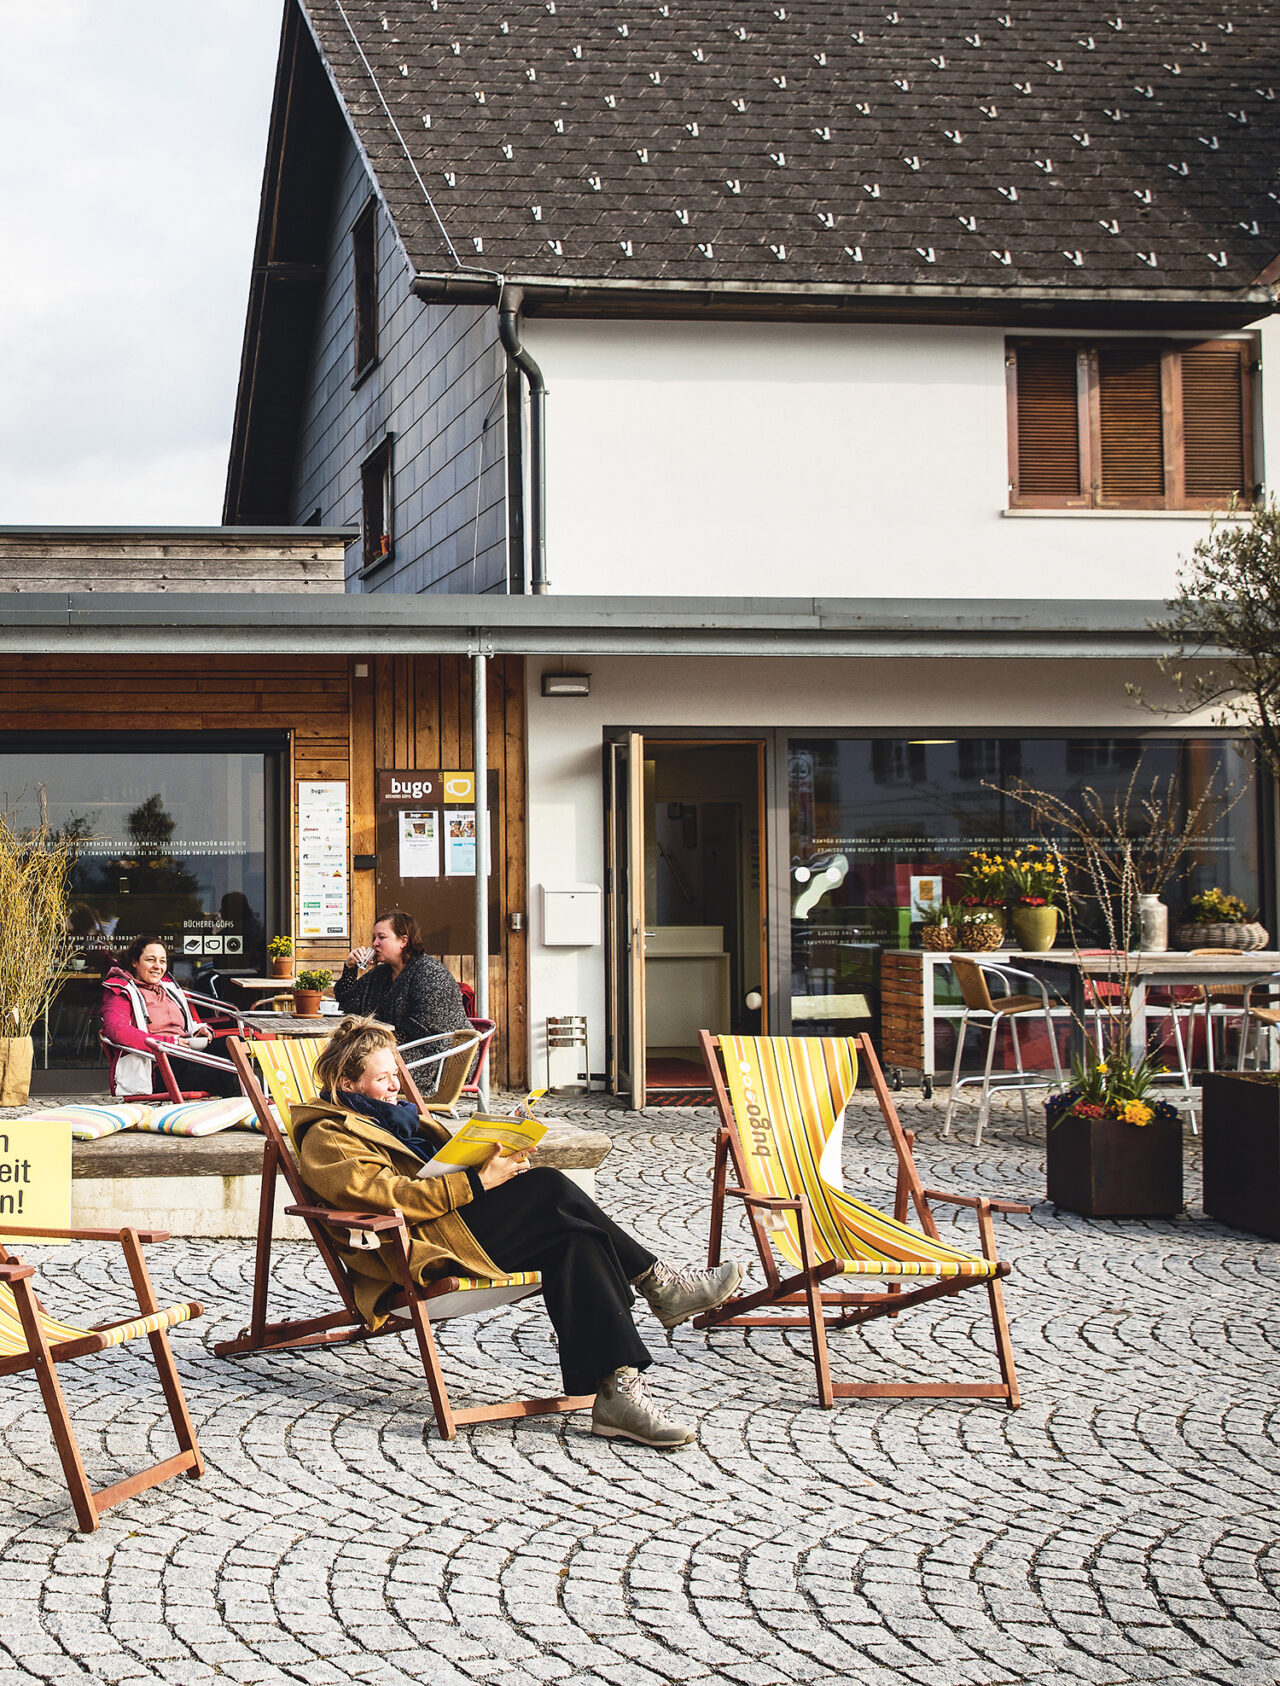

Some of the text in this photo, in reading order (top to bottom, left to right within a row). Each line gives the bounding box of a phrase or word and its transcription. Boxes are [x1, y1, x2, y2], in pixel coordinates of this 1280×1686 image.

[391, 777, 432, 799] bugo
[183, 919, 235, 928] BÜCHEREI GÖFIS
[747, 1104, 771, 1157] bugo
